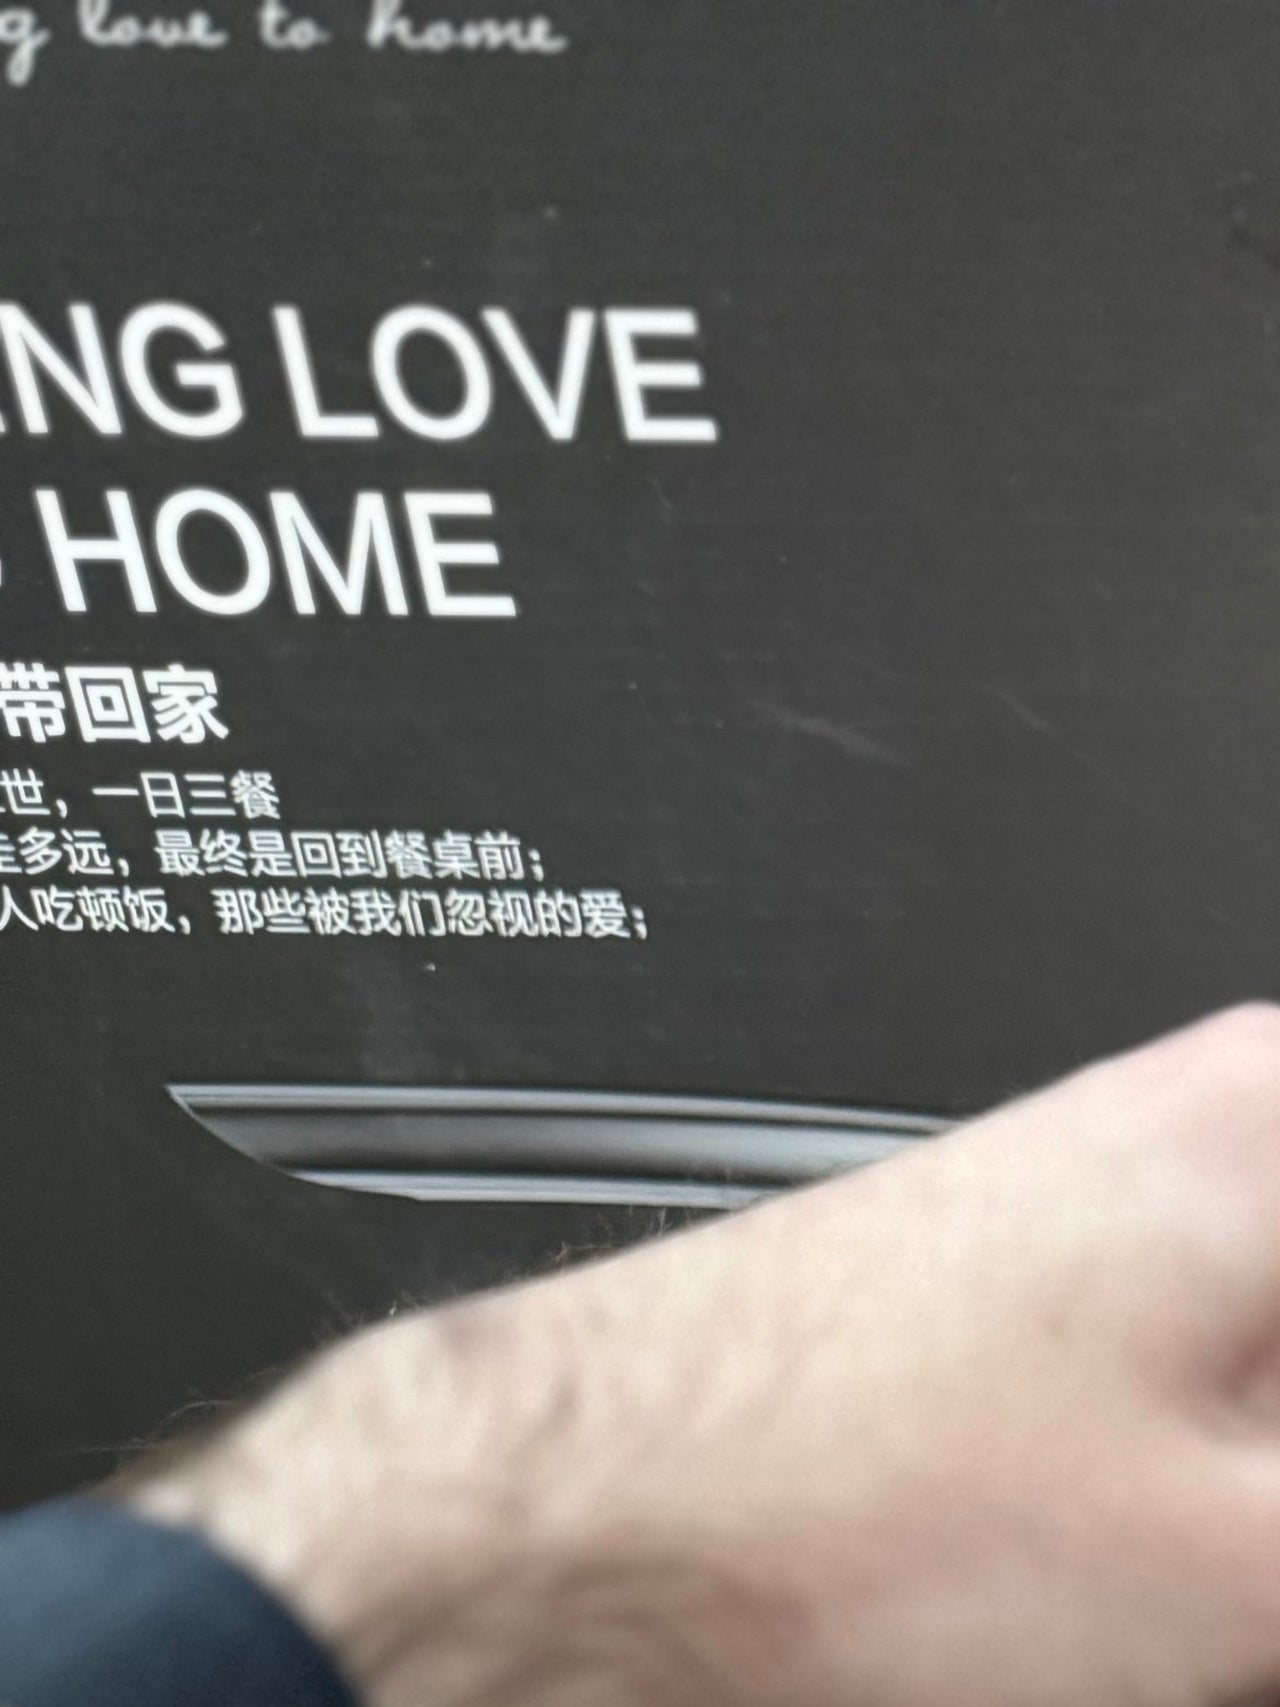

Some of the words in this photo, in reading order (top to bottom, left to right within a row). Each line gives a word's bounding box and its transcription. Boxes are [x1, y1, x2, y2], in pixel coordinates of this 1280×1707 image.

[77, 0, 229, 48] love
[260, 0, 330, 49] to
[366, 0, 571, 53] home
[0, 302, 243, 438] NG
[273, 305, 717, 442] LOVE
[35, 488, 517, 617] HOME
[0, 662, 230, 744] 带回家
[0, 768, 281, 820] 世，一日三餐
